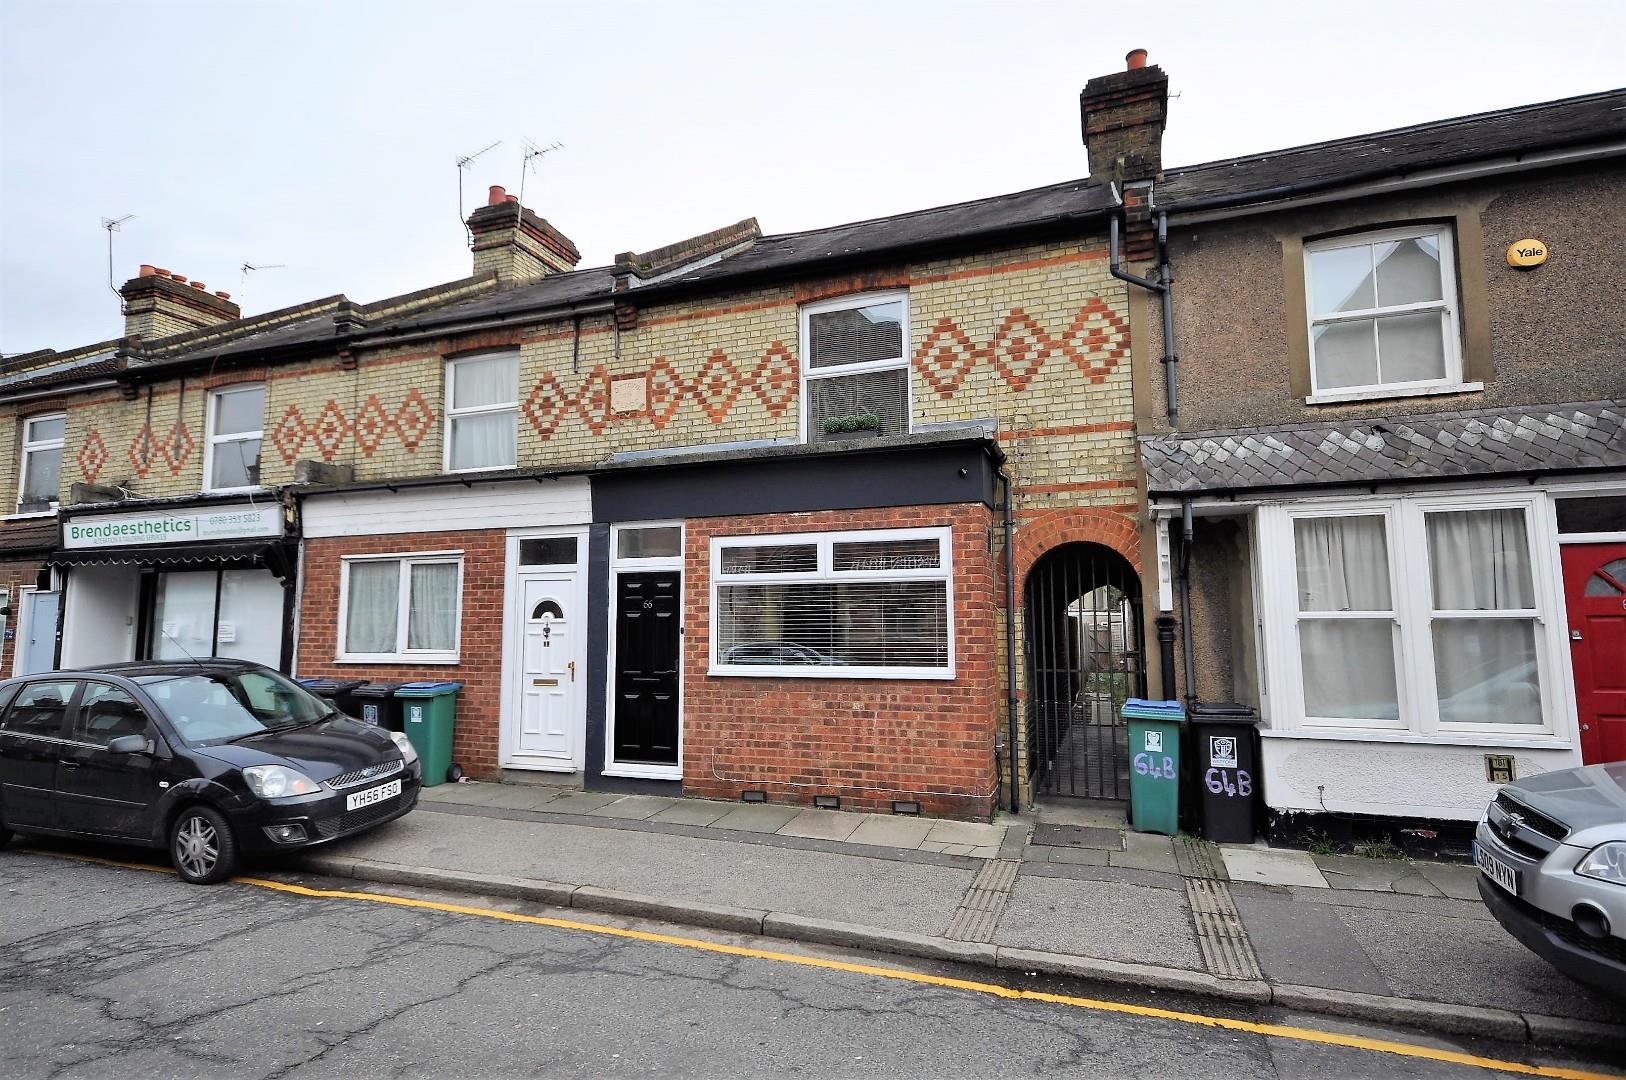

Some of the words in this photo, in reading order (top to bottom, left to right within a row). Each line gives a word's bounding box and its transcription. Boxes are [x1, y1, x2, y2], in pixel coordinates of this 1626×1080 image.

[1517, 248, 1543, 257] Yale
[71, 518, 191, 539] Brendaesthetics
[643, 599, 653, 609] 66
[1134, 752, 1176, 779] 64B
[1205, 767, 1252, 797] 64B
[352, 789, 379, 807] YH56
